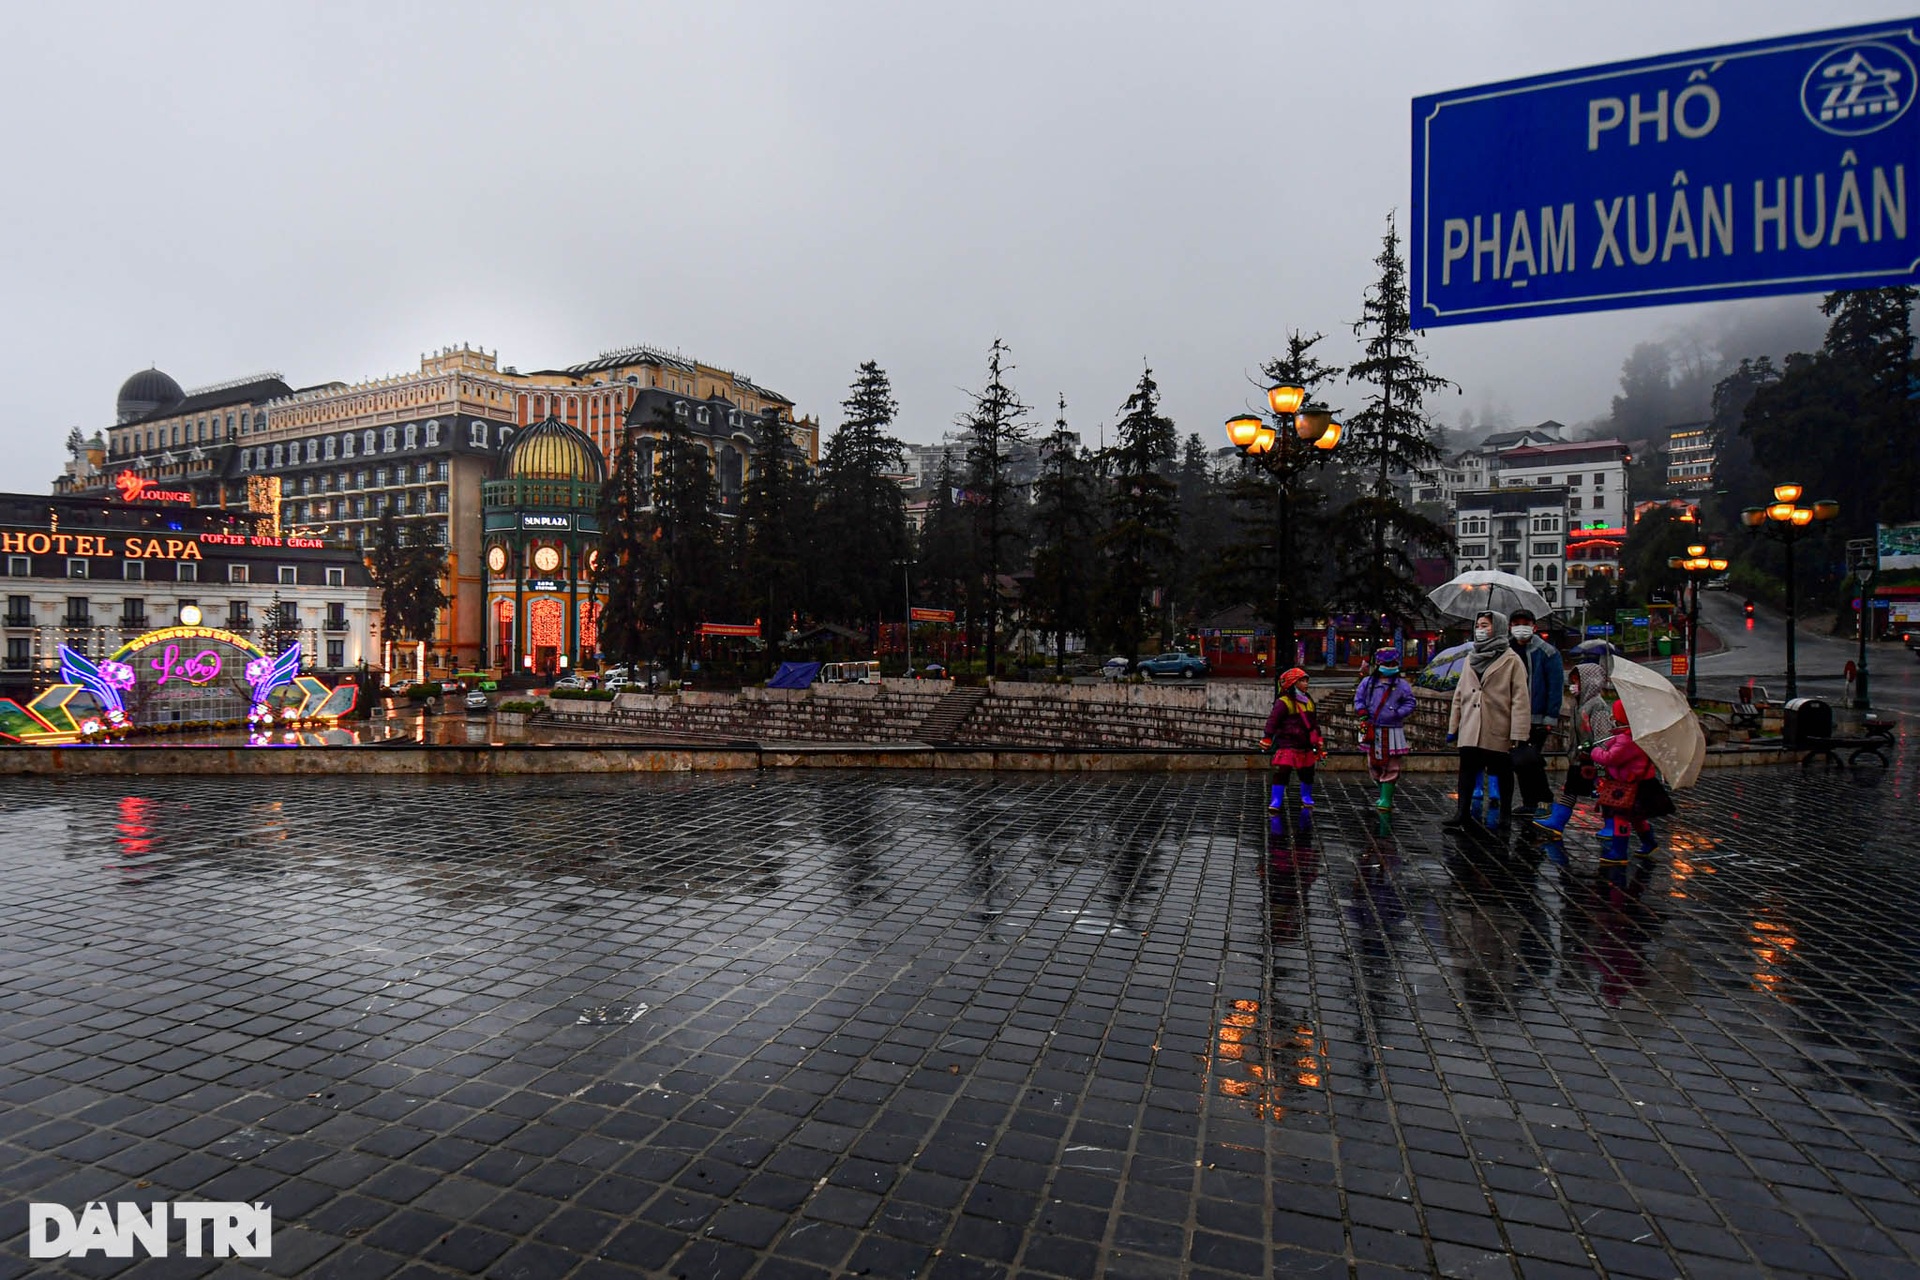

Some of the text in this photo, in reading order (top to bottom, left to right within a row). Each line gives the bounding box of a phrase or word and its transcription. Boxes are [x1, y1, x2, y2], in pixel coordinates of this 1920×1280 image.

[1588, 60, 1727, 151] PHỐ
[1442, 149, 1907, 288] PHẠM XUÂN HUÂN
[141, 490, 191, 502] LOUNGE
[524, 516, 568, 526] SUN PLAZA
[1, 532, 203, 560] HOTEL SAPA
[287, 538, 324, 548] CIGAR
